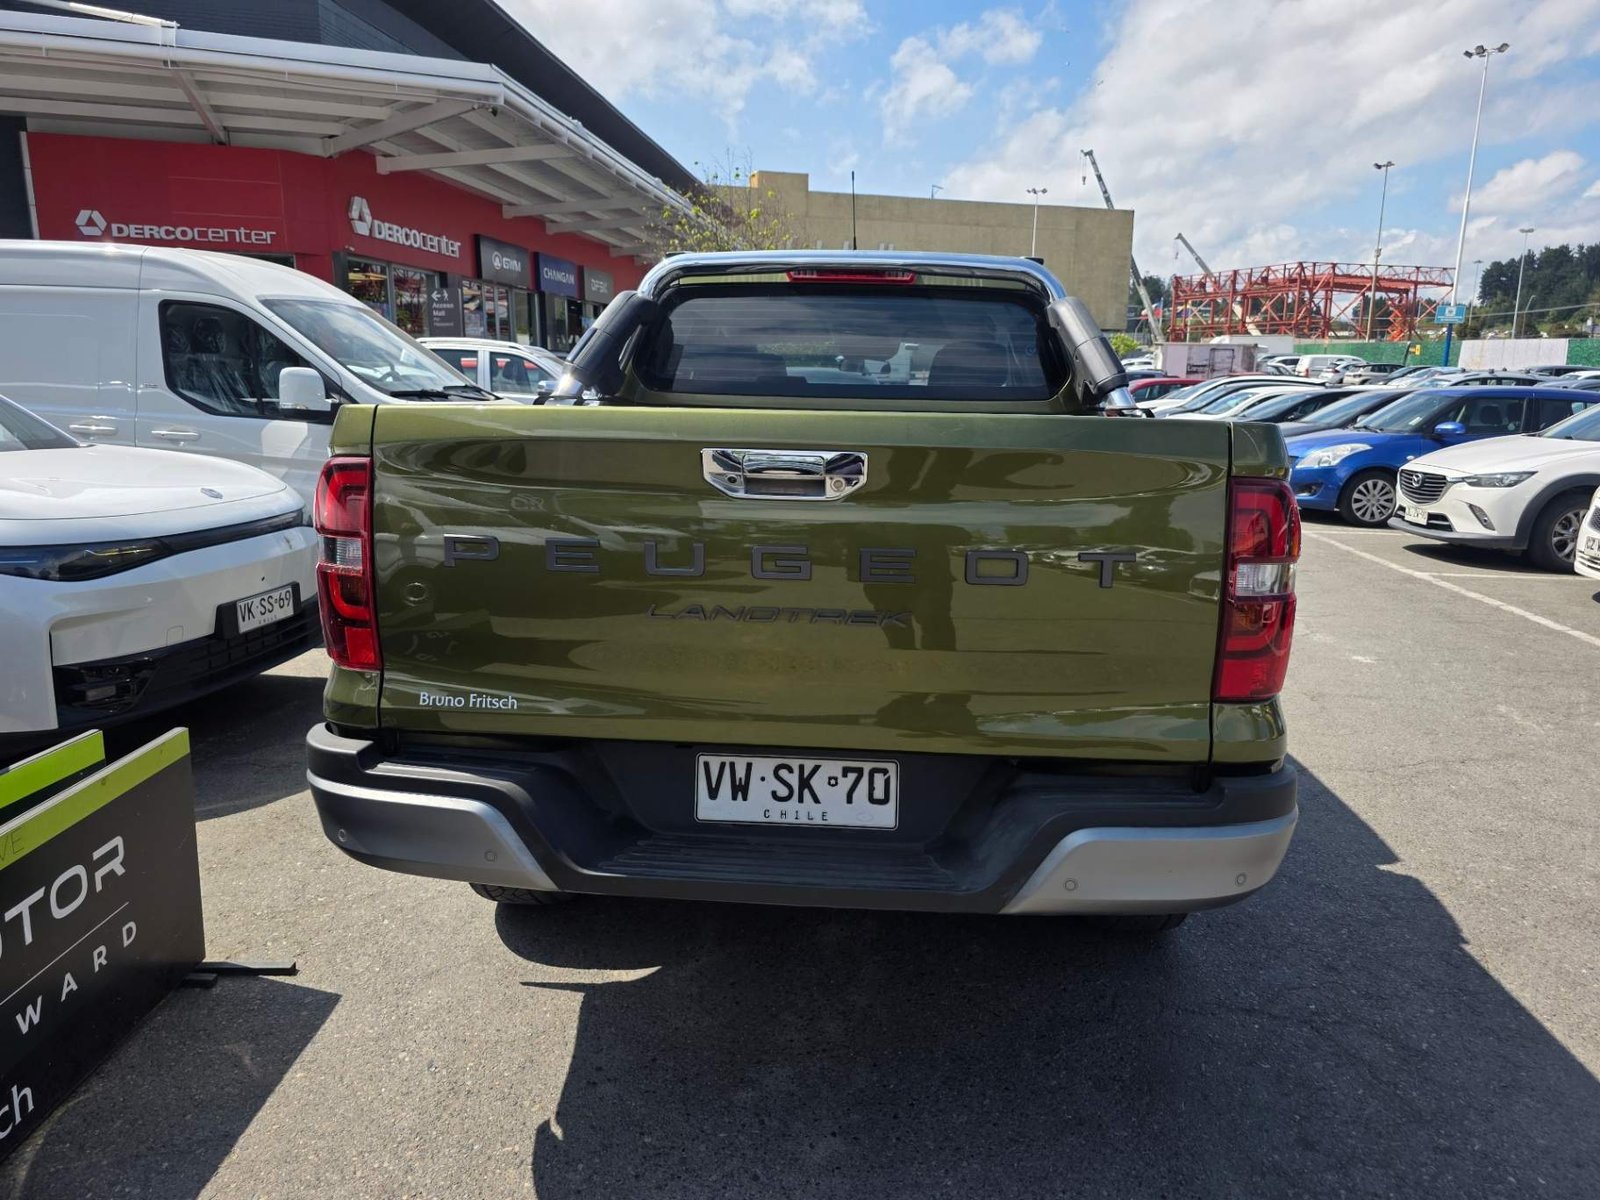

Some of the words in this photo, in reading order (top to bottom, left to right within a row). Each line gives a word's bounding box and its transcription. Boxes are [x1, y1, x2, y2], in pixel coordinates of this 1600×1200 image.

[111, 223, 276, 244] DERCOcenter
[372, 219, 461, 258] DERCOcenter
[543, 267, 575, 285] CHANGAN
[443, 533, 1137, 588] PEUGEOT
[646, 603, 912, 629] LANDTREK
[419, 691, 465, 707] Bruno
[469, 694, 518, 710] Fritsch
[763, 808, 828, 821] CHILE
[0, 835, 126, 958] TOR
